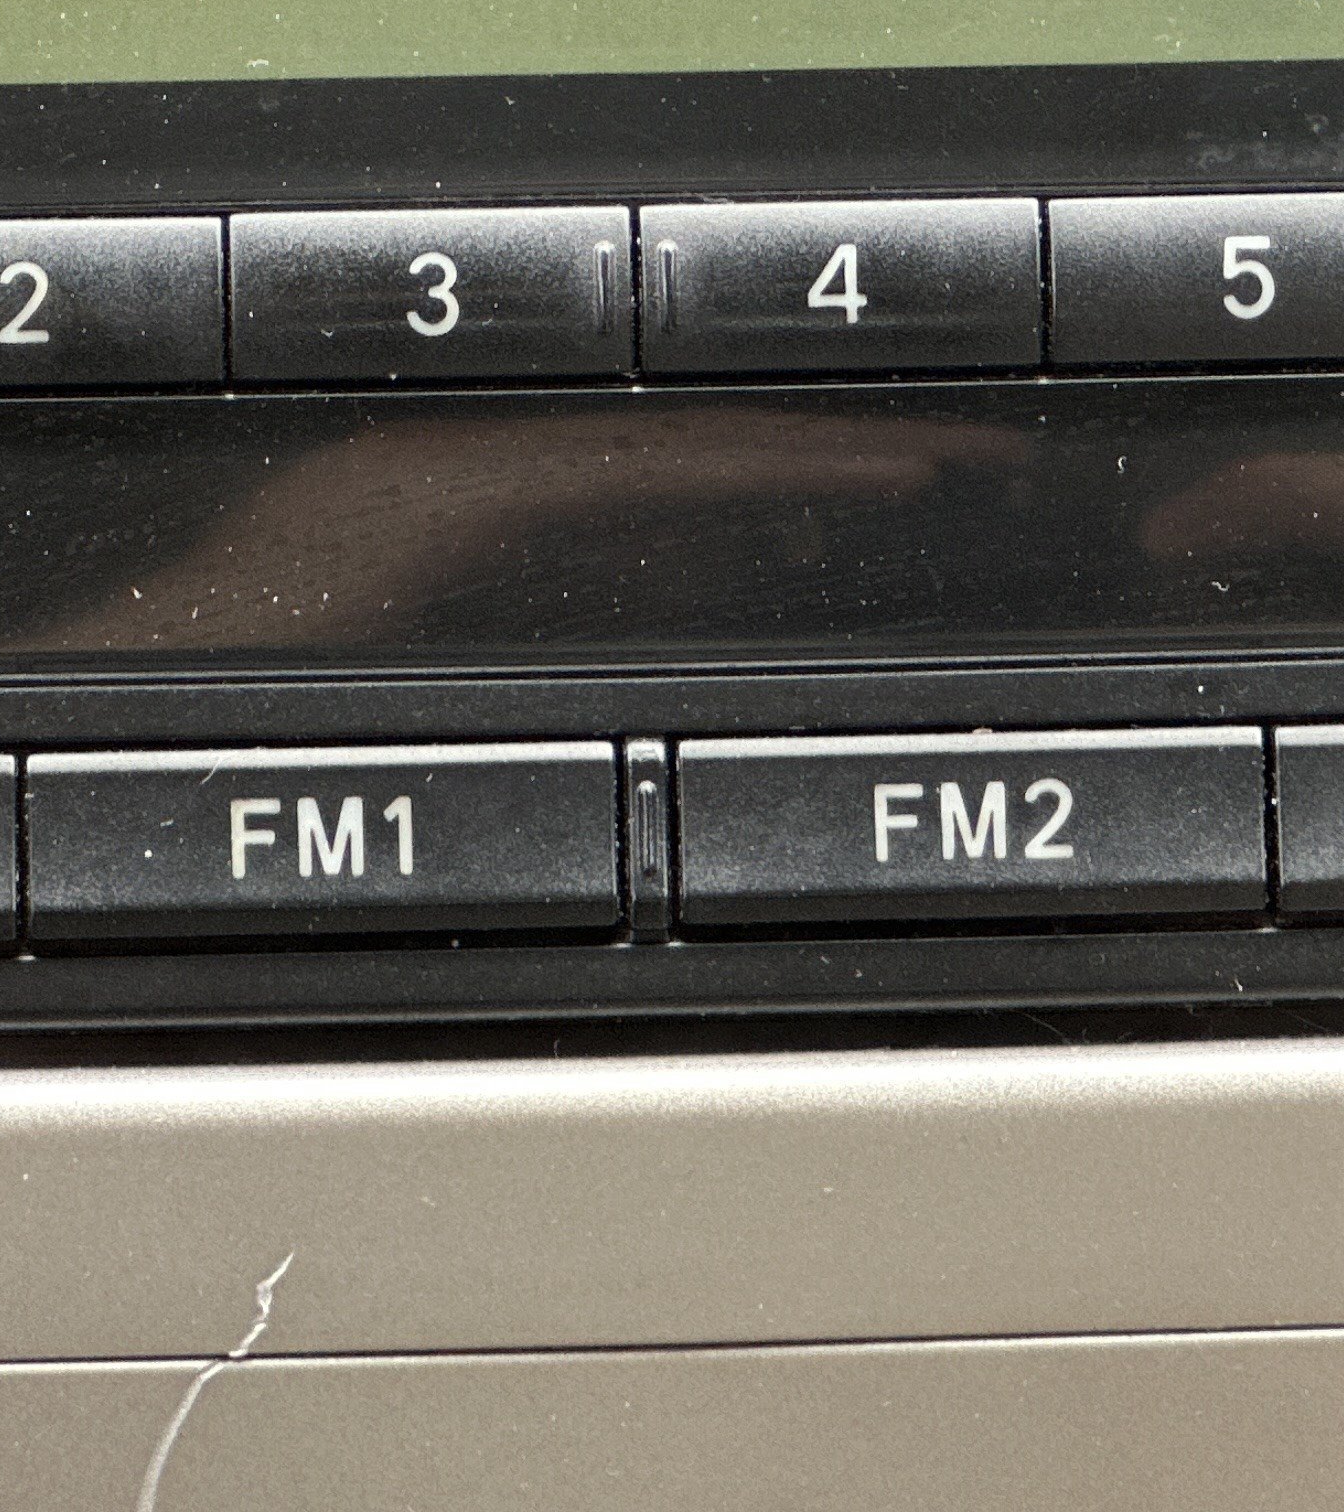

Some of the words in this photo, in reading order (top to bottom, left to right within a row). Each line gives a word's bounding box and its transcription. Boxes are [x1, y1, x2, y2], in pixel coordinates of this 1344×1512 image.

[407, 251, 460, 337] 3
[806, 243, 867, 324] 4
[1222, 235, 1275, 320] 5
[230, 795, 413, 878] FM1
[874, 778, 1074, 862] FM2
